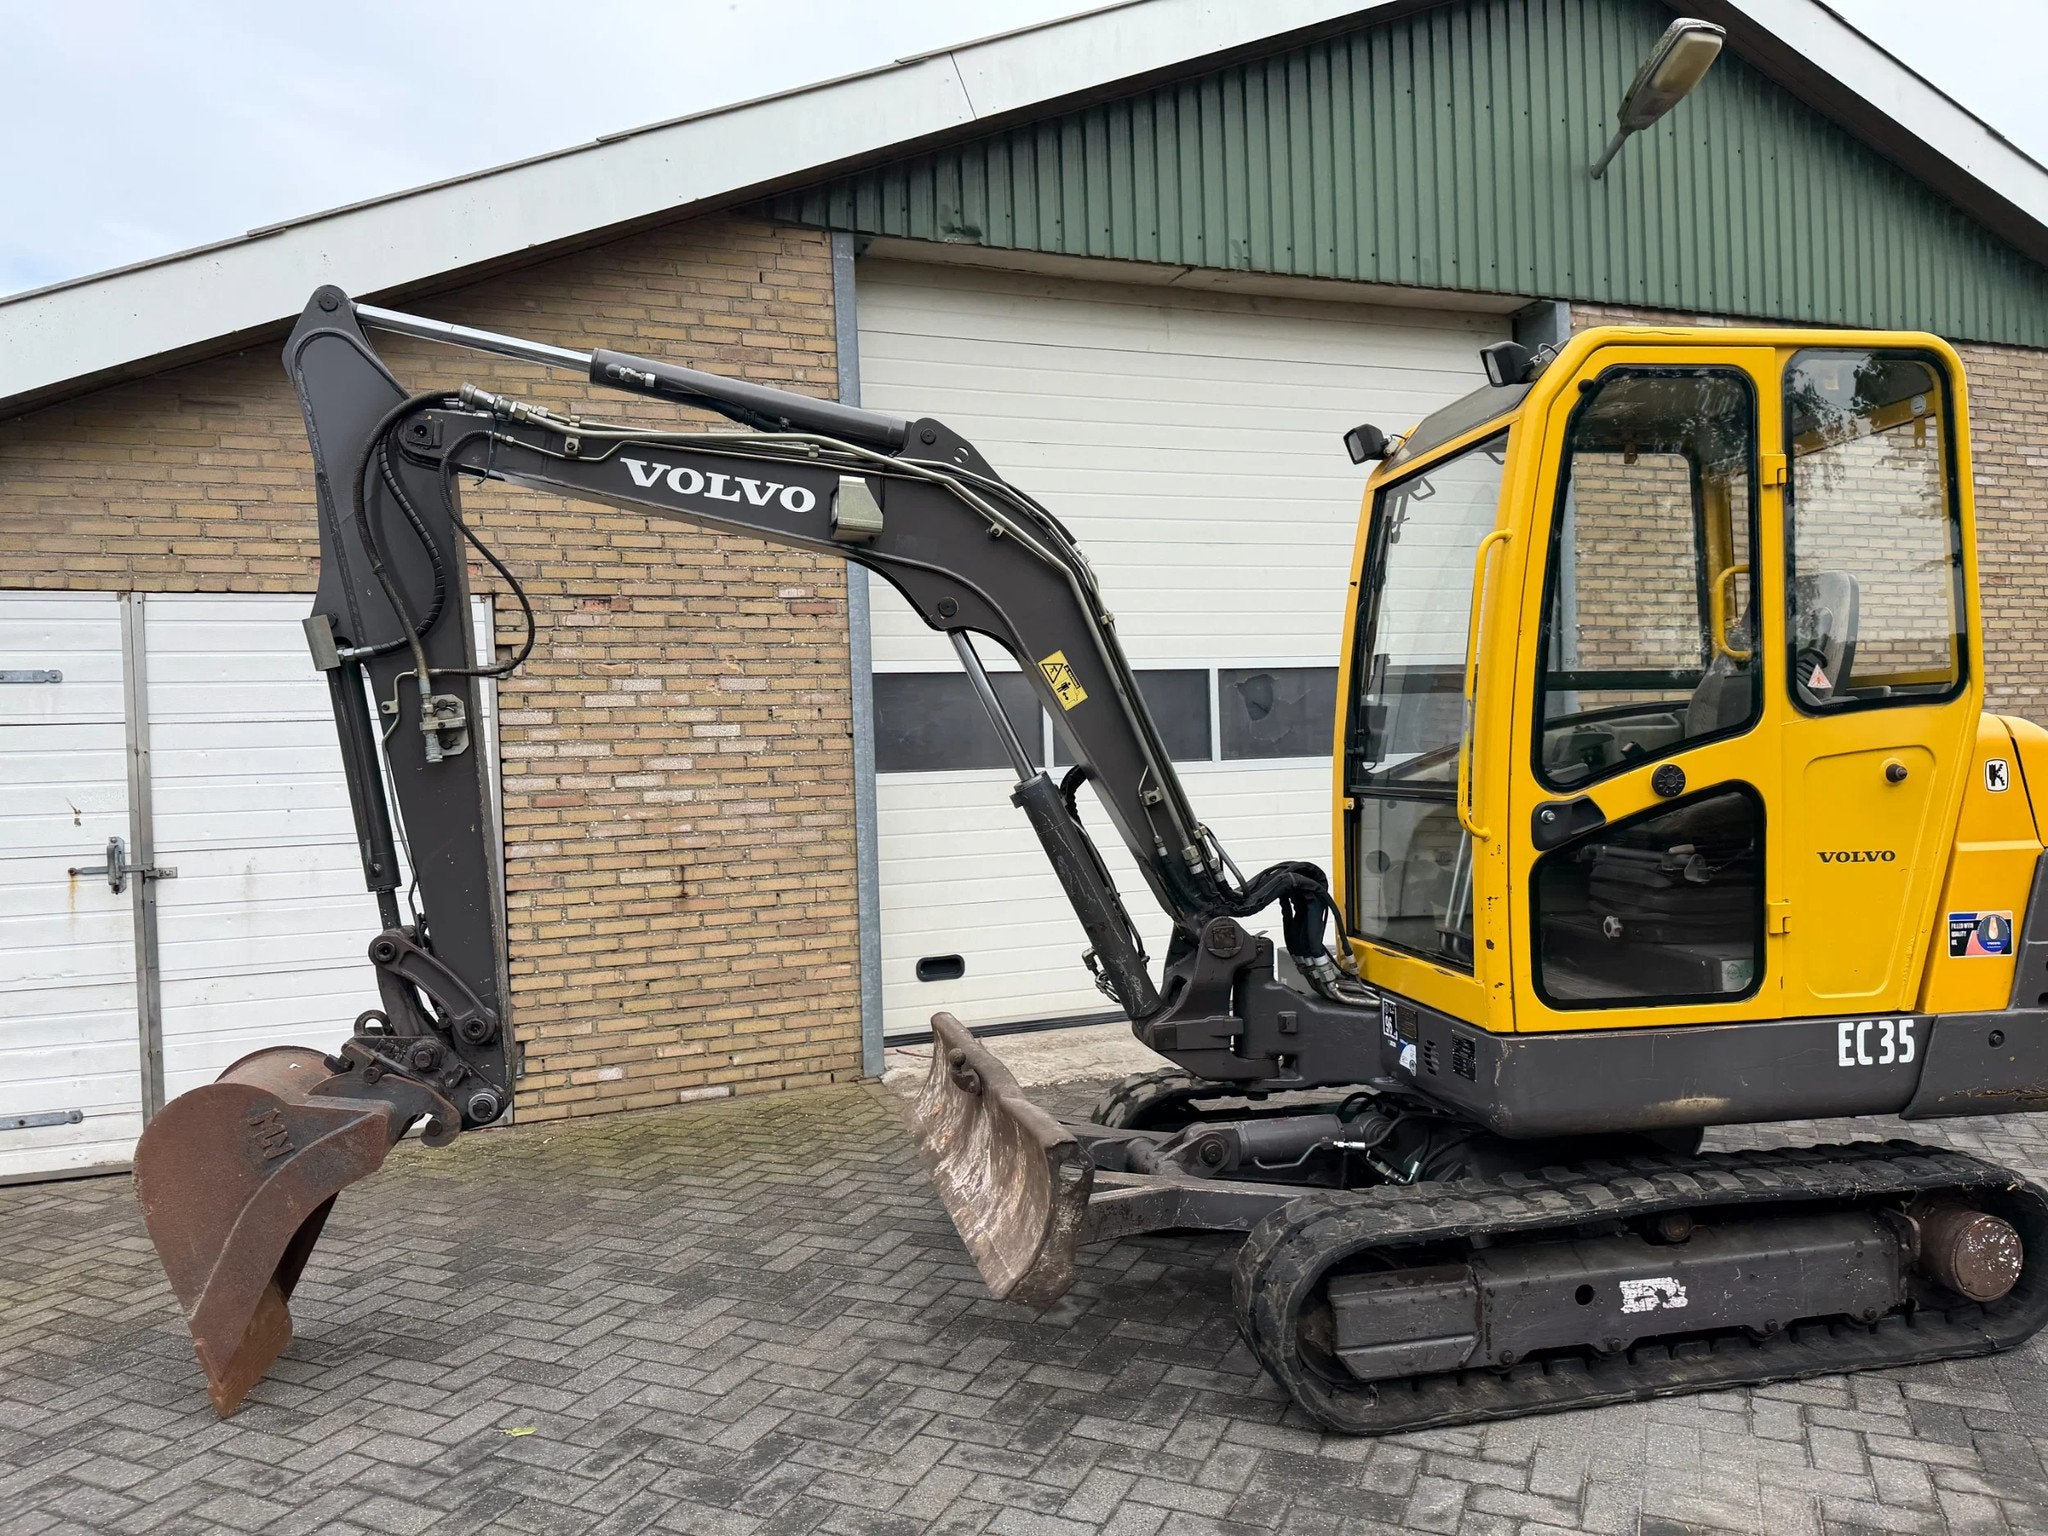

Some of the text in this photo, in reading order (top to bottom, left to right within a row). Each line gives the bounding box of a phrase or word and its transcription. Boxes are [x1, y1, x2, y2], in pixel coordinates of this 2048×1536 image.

[620, 457, 816, 513] VOLVO
[1817, 850, 1896, 863] VOLVO
[1838, 1019, 1915, 1067] EC35
